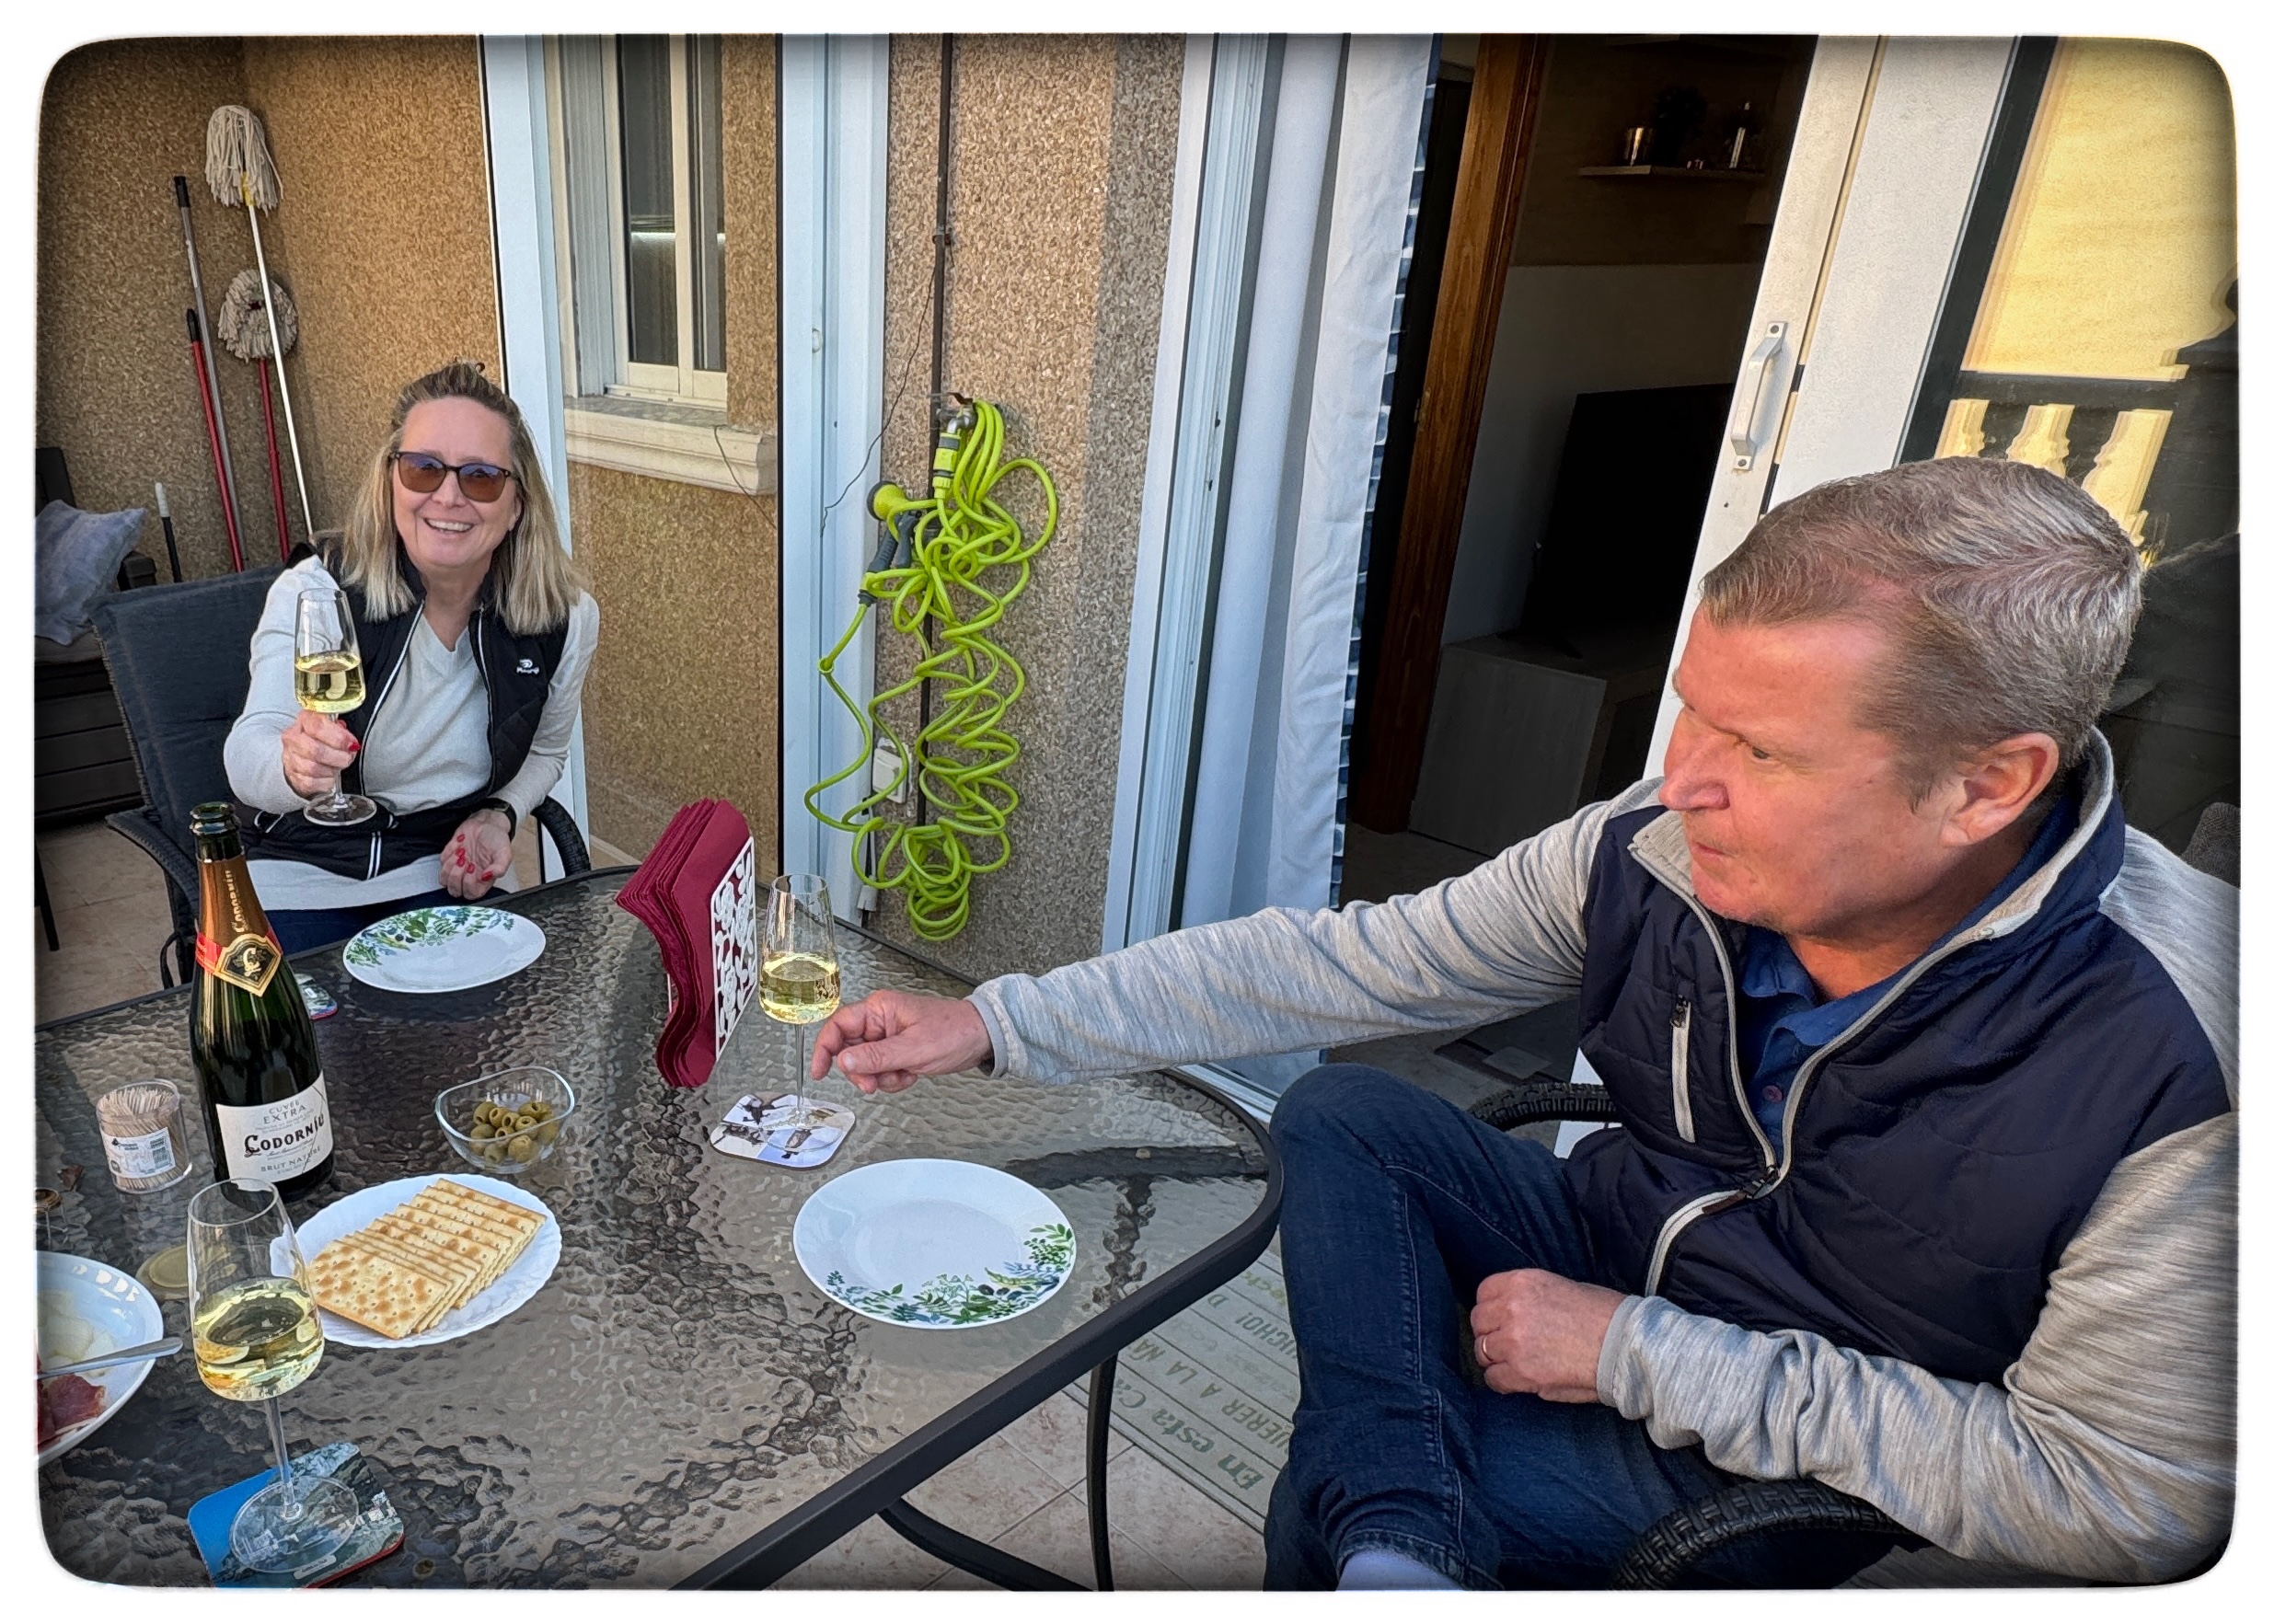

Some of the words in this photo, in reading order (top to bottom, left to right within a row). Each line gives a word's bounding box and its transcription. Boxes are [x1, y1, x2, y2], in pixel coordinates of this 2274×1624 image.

[263, 1105, 306, 1124] EXTRA
[260, 1162, 286, 1172] BRUT
[1234, 1312, 1297, 1359] UCHO!
[1165, 1361, 1197, 1385] LA
[1199, 1383, 1223, 1399] A
[1151, 1408, 1214, 1453] esta
[1221, 1399, 1290, 1454] UERER
[1218, 1454, 1264, 1491] En
